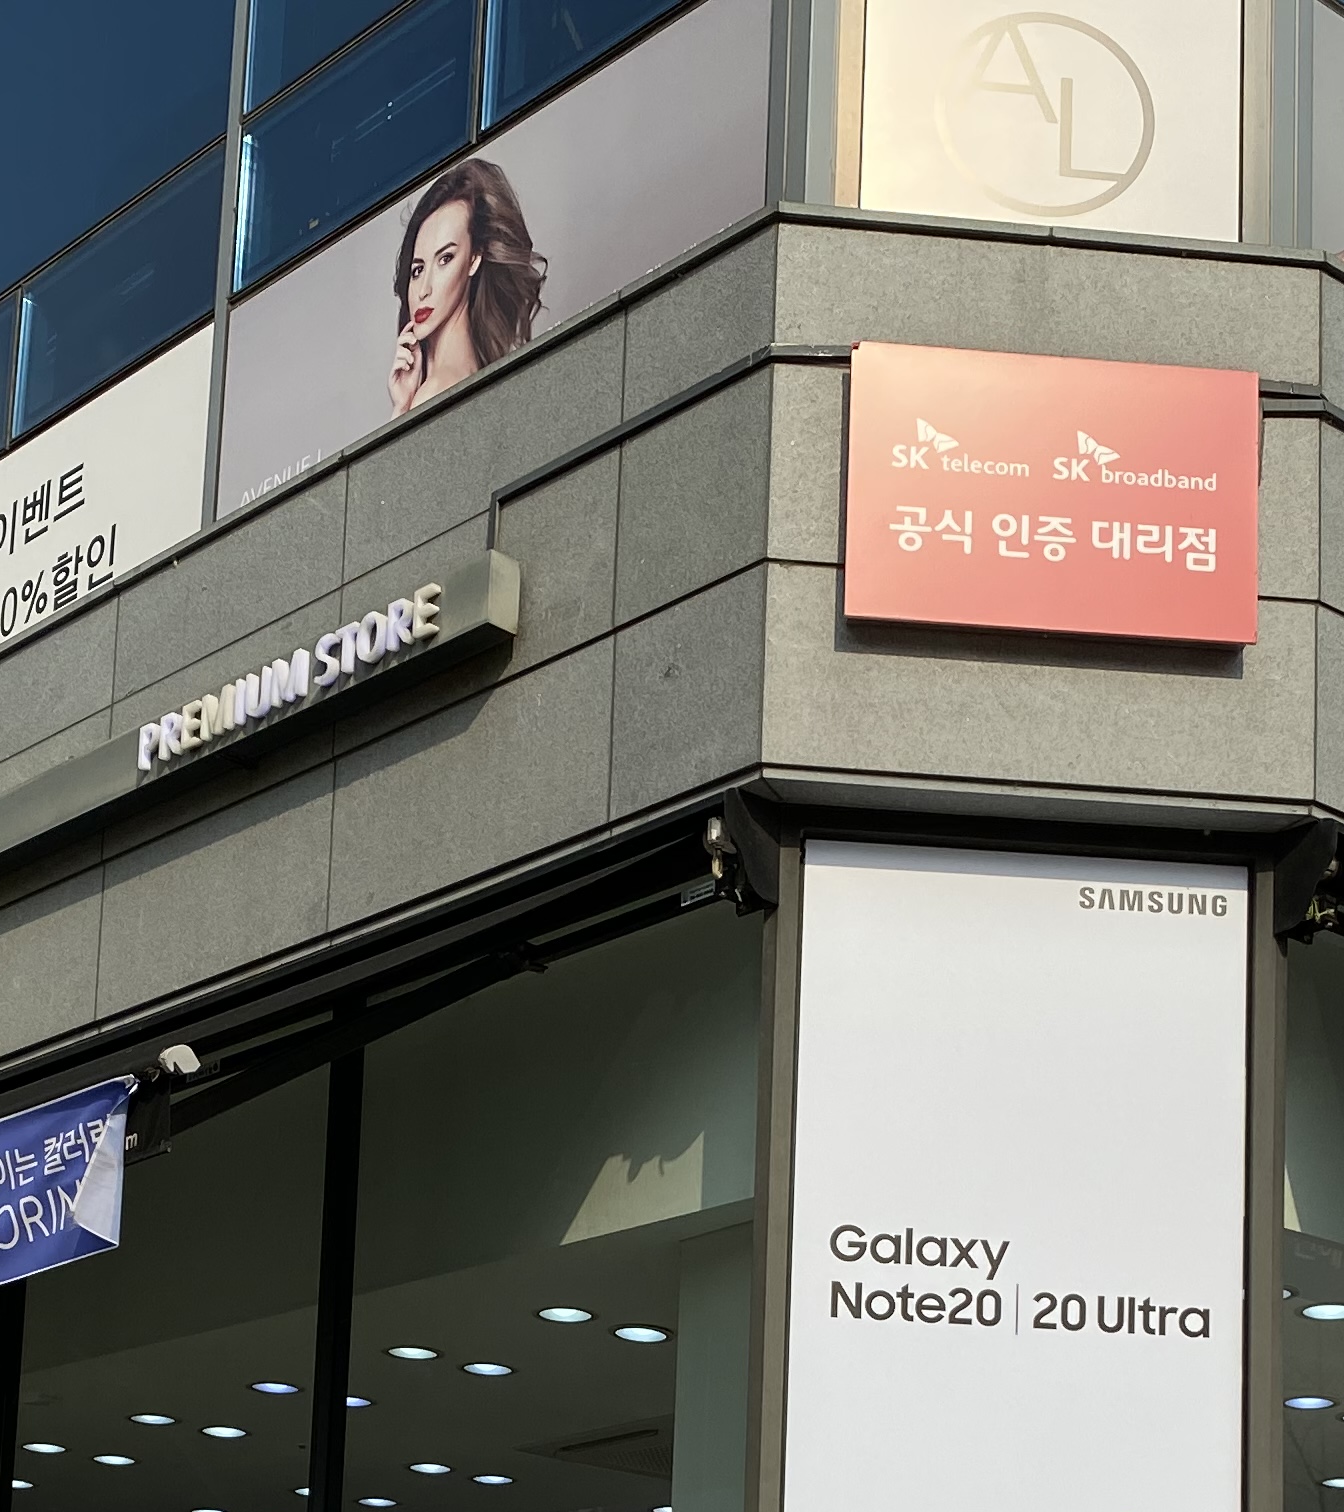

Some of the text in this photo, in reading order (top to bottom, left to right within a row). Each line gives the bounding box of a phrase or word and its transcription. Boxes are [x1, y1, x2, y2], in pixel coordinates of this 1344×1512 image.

[892, 443, 1218, 493] SK telecom SK broadband
[891, 504, 1218, 574] 공식 인증 대리점
[137, 582, 442, 772] PREMIUM STORE
[1079, 886, 1228, 918] SAMSUNG
[830, 1224, 1010, 1280] Galaxy
[830, 1280, 1211, 1339] Note20 20 Ultra
